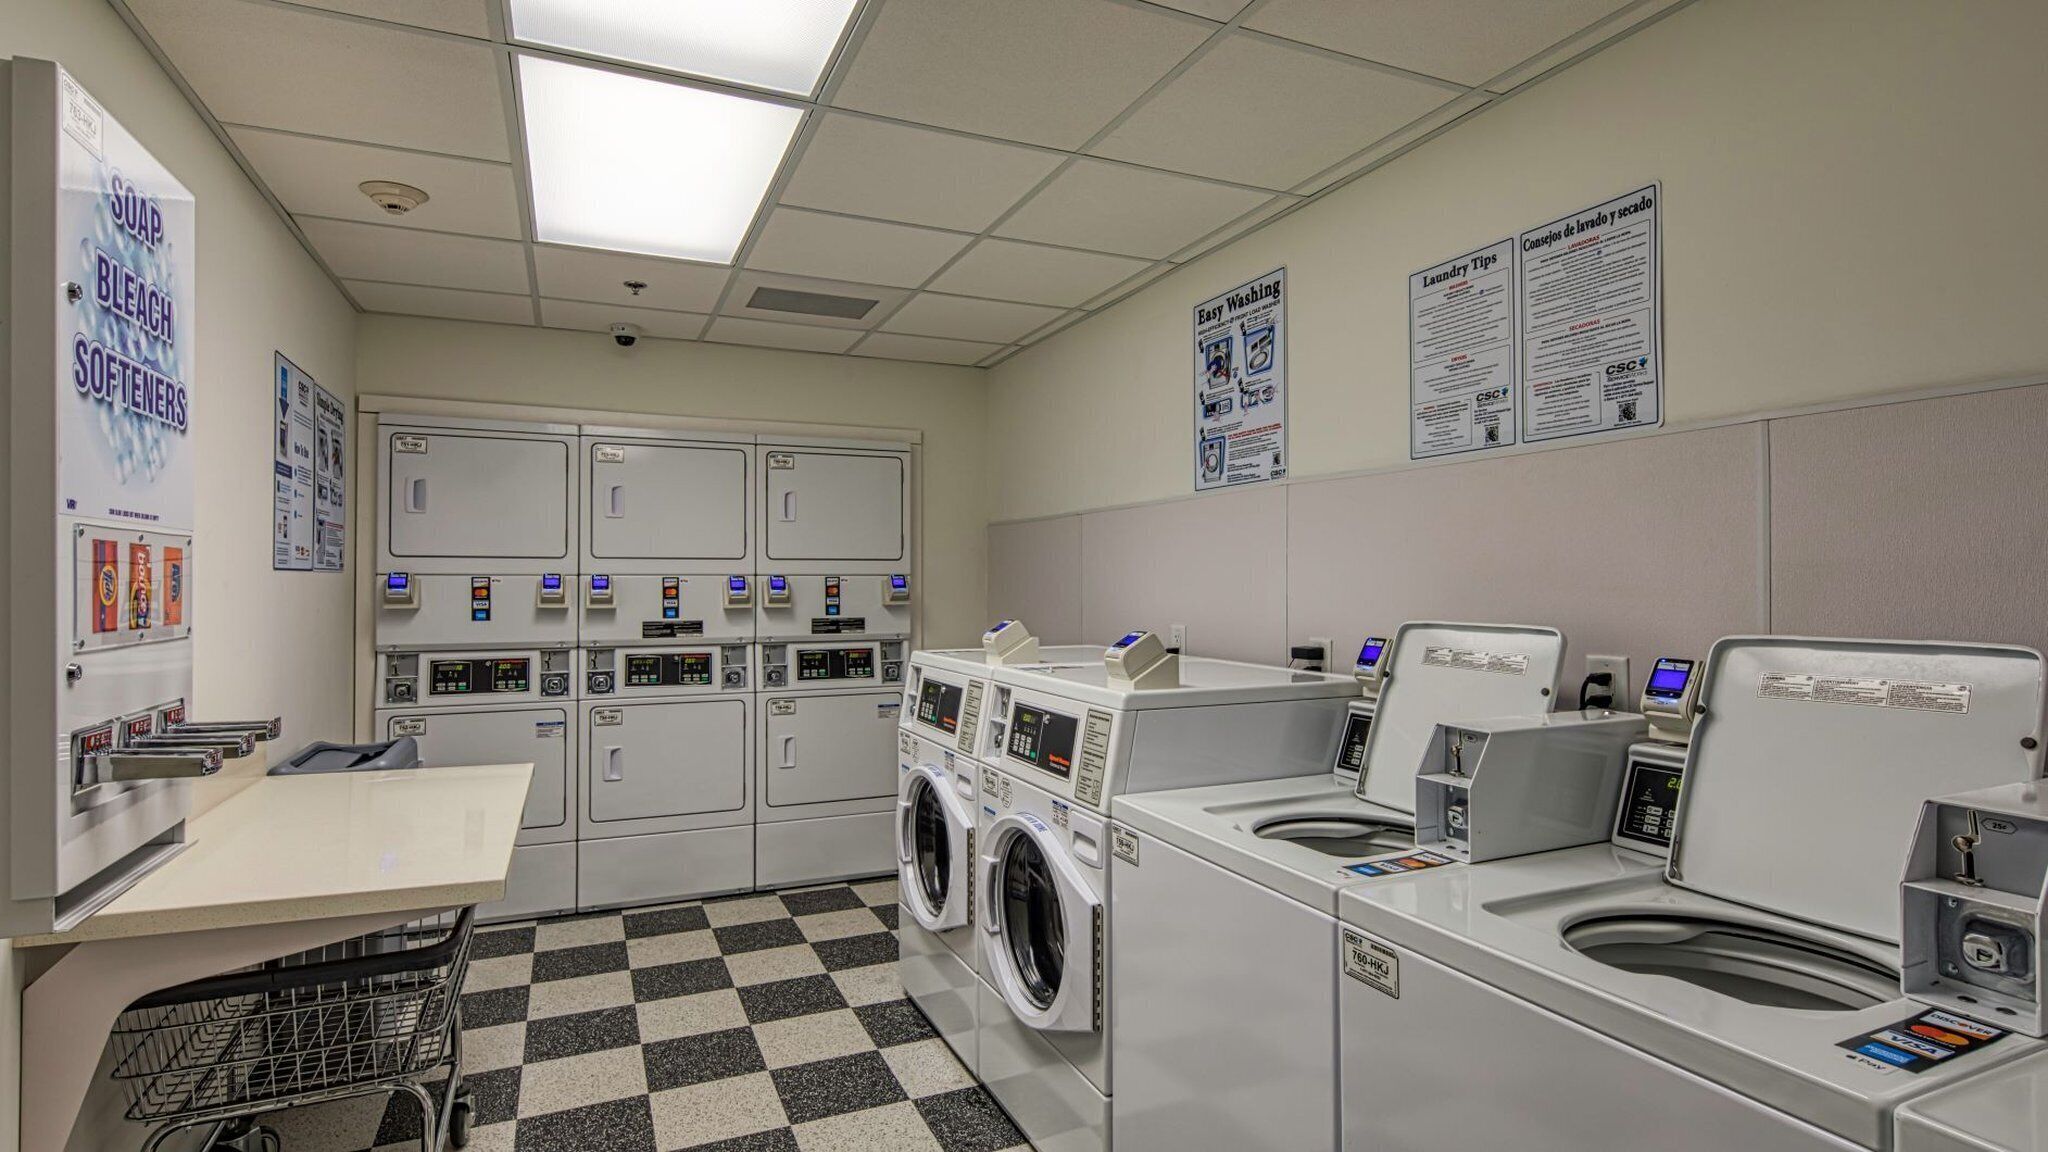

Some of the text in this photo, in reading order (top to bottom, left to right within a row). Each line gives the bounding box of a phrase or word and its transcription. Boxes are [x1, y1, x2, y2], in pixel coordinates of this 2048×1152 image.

[111, 172, 163, 246] SOAP
[1523, 230, 1562, 252] Consejos
[1563, 223, 1575, 238] de
[1576, 211, 1608, 234] lavado
[1610, 210, 1616, 226] y
[1618, 196, 1652, 219] secado
[1423, 253, 1498, 288] Laundry Tips
[97, 250, 173, 343] BLEACH
[1197, 305, 1224, 326] Easy
[1226, 280, 1281, 313] Washing
[74, 334, 187, 430] SOFTENERS
[1605, 360, 1637, 375] CSC
[1476, 389, 1500, 402] CSC
[103, 569, 114, 601] Tide
[137, 551, 148, 615] bounce
[1352, 949, 1390, 976] 760-HKJ
[1930, 1013, 1994, 1034] DISCOVER
[1890, 1034, 1938, 1055] VISA
